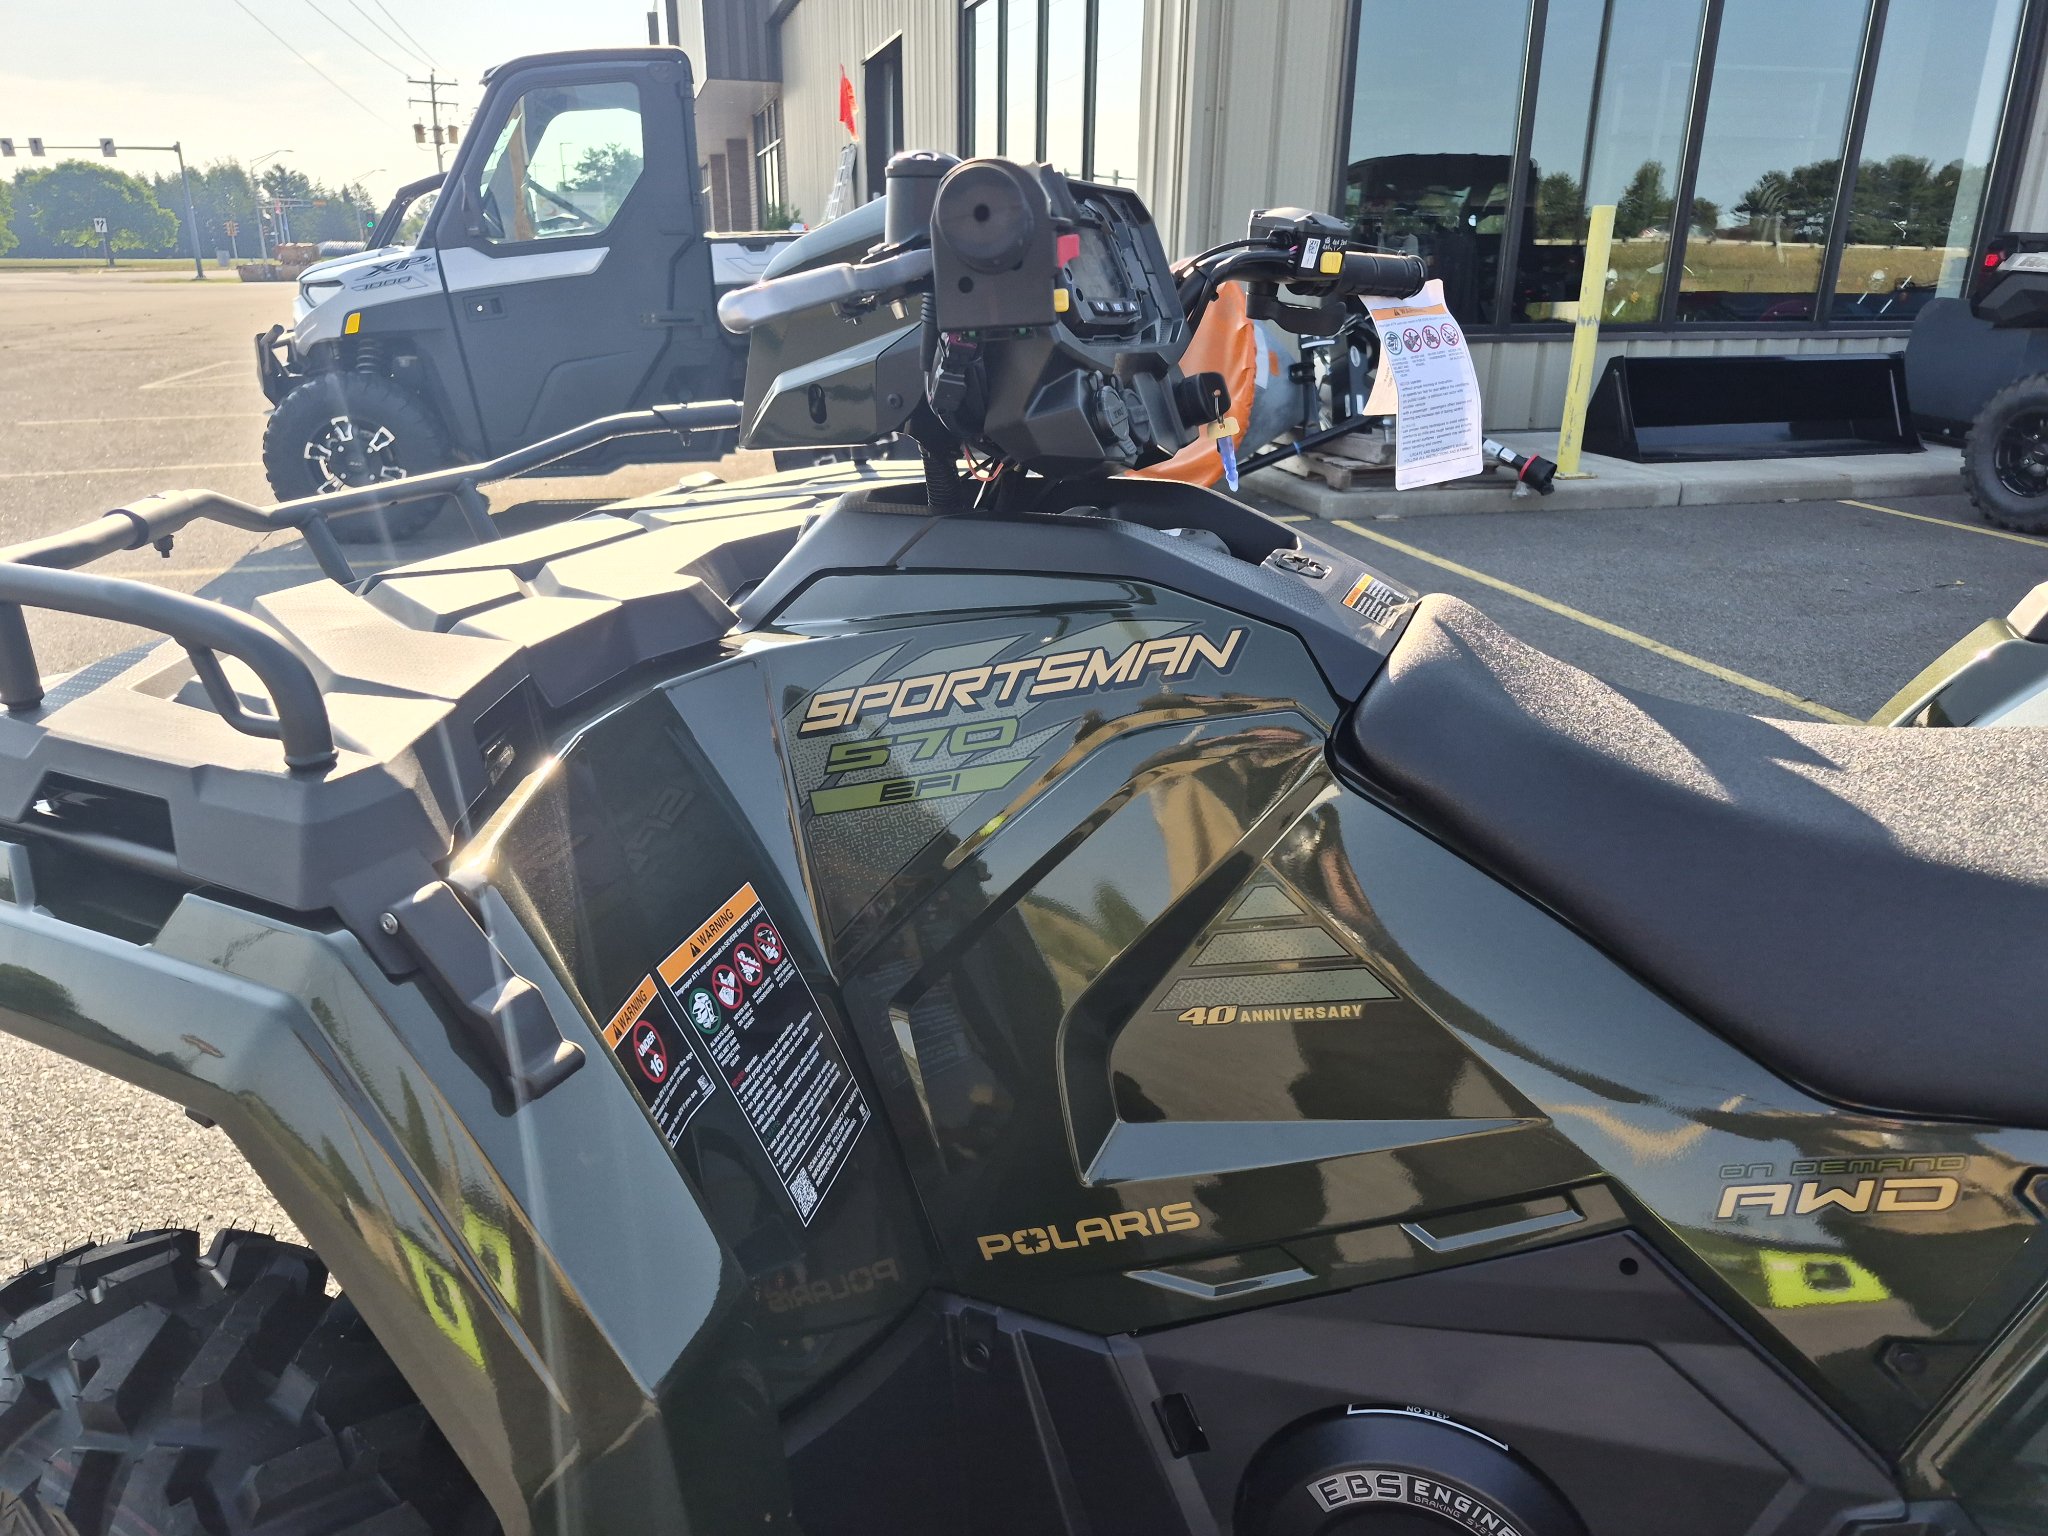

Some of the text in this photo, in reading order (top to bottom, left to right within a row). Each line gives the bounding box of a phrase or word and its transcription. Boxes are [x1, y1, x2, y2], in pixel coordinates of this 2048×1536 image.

[800, 628, 1249, 736] SPORTSMAN
[825, 717, 1019, 774] 570
[880, 773, 962, 802] EFI
[696, 906, 734, 947] WARNING
[617, 989, 648, 1030] WARNING
[1240, 1004, 1362, 1023] ANNIVERSARY
[636, 1029, 657, 1058] UNDER
[648, 1052, 665, 1078] 16
[1719, 1155, 1969, 1180] ON DEMAND
[1716, 1177, 1960, 1220] AWD
[976, 1201, 1201, 1261] POLARIS
[1406, 1405, 1450, 1419] NO STEP
[1317, 1473, 1404, 1507] EBS
[1414, 1495, 1461, 1518] BRAKING
